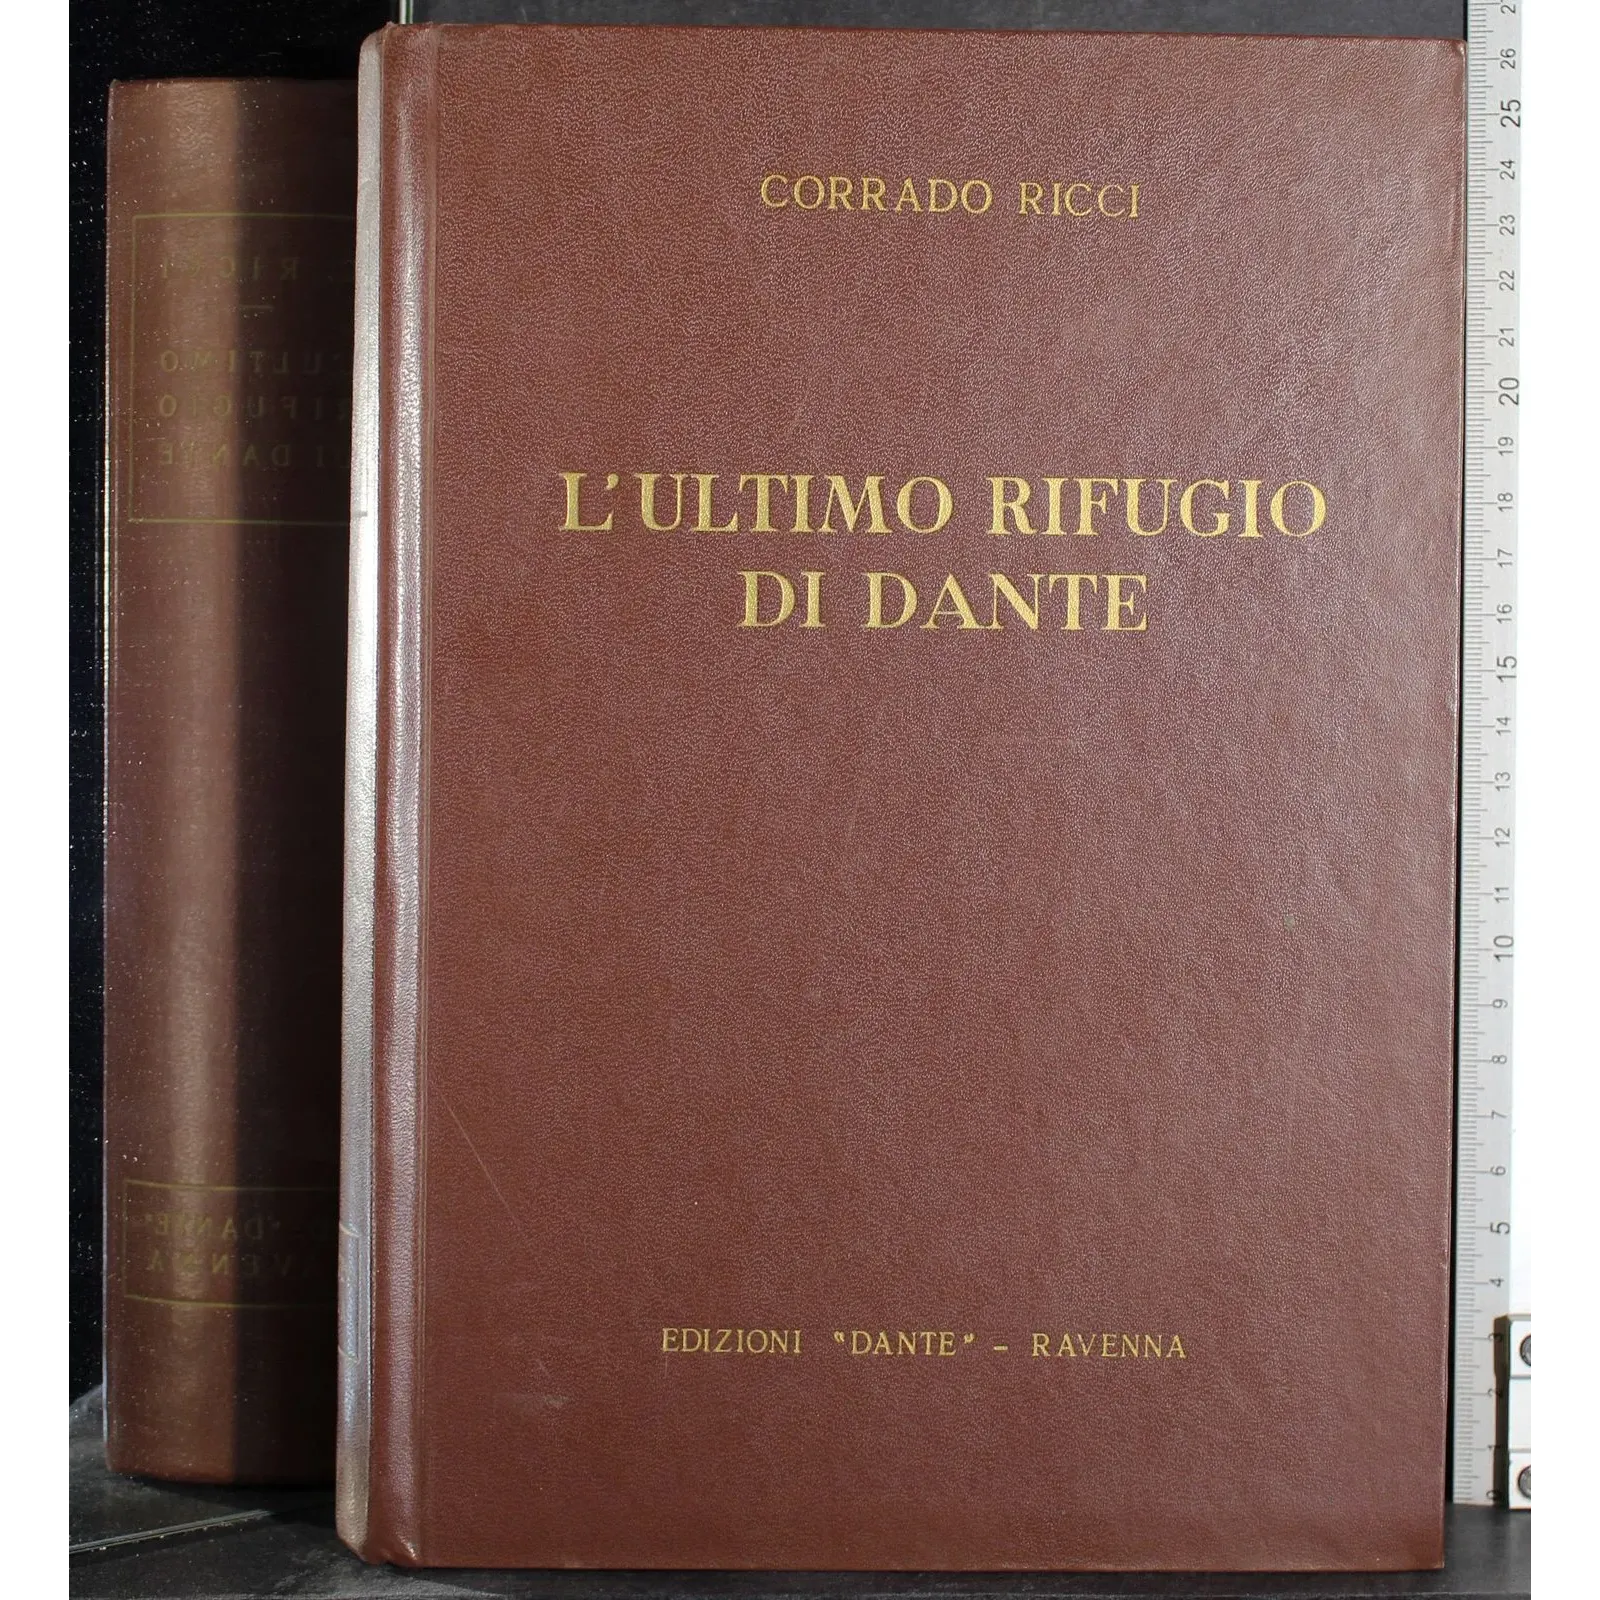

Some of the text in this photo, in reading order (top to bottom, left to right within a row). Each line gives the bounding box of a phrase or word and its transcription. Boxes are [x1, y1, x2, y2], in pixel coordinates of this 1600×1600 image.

[1500, 47, 1516, 70] 26
[1500, 99, 1521, 128] 25
[1500, 158, 1516, 180] 24
[760, 174, 1141, 220] CORRADO RICCI
[1500, 214, 1516, 236] 23
[1499, 269, 1515, 291] 22
[1499, 327, 1515, 347] 21
[1499, 377, 1520, 406] 20
[1498, 436, 1514, 456] 19
[562, 472, 1329, 540] L'ULTIMO RIFUGIO
[1497, 492, 1514, 512] 18
[1498, 548, 1513, 569] 17
[741, 570, 1150, 634] DI DANTE
[1497, 603, 1512, 624] 16
[1497, 655, 1517, 683] 15
[1497, 716, 1511, 736] 14
[1495, 771, 1511, 792] 13
[1494, 827, 1511, 848] 12
[1494, 886, 1509, 904] 11
[1493, 934, 1514, 962] 10
[1491, 1054, 1508, 1065] 8
[1491, 1110, 1507, 1121] 7
[1489, 1221, 1510, 1235] 5
[1489, 1277, 1504, 1288] 4
[662, 1329, 802, 1355] EDIZIONI
[834, 1331, 976, 1358] "DANTE"
[1032, 1333, 1187, 1360] RAVENNA
